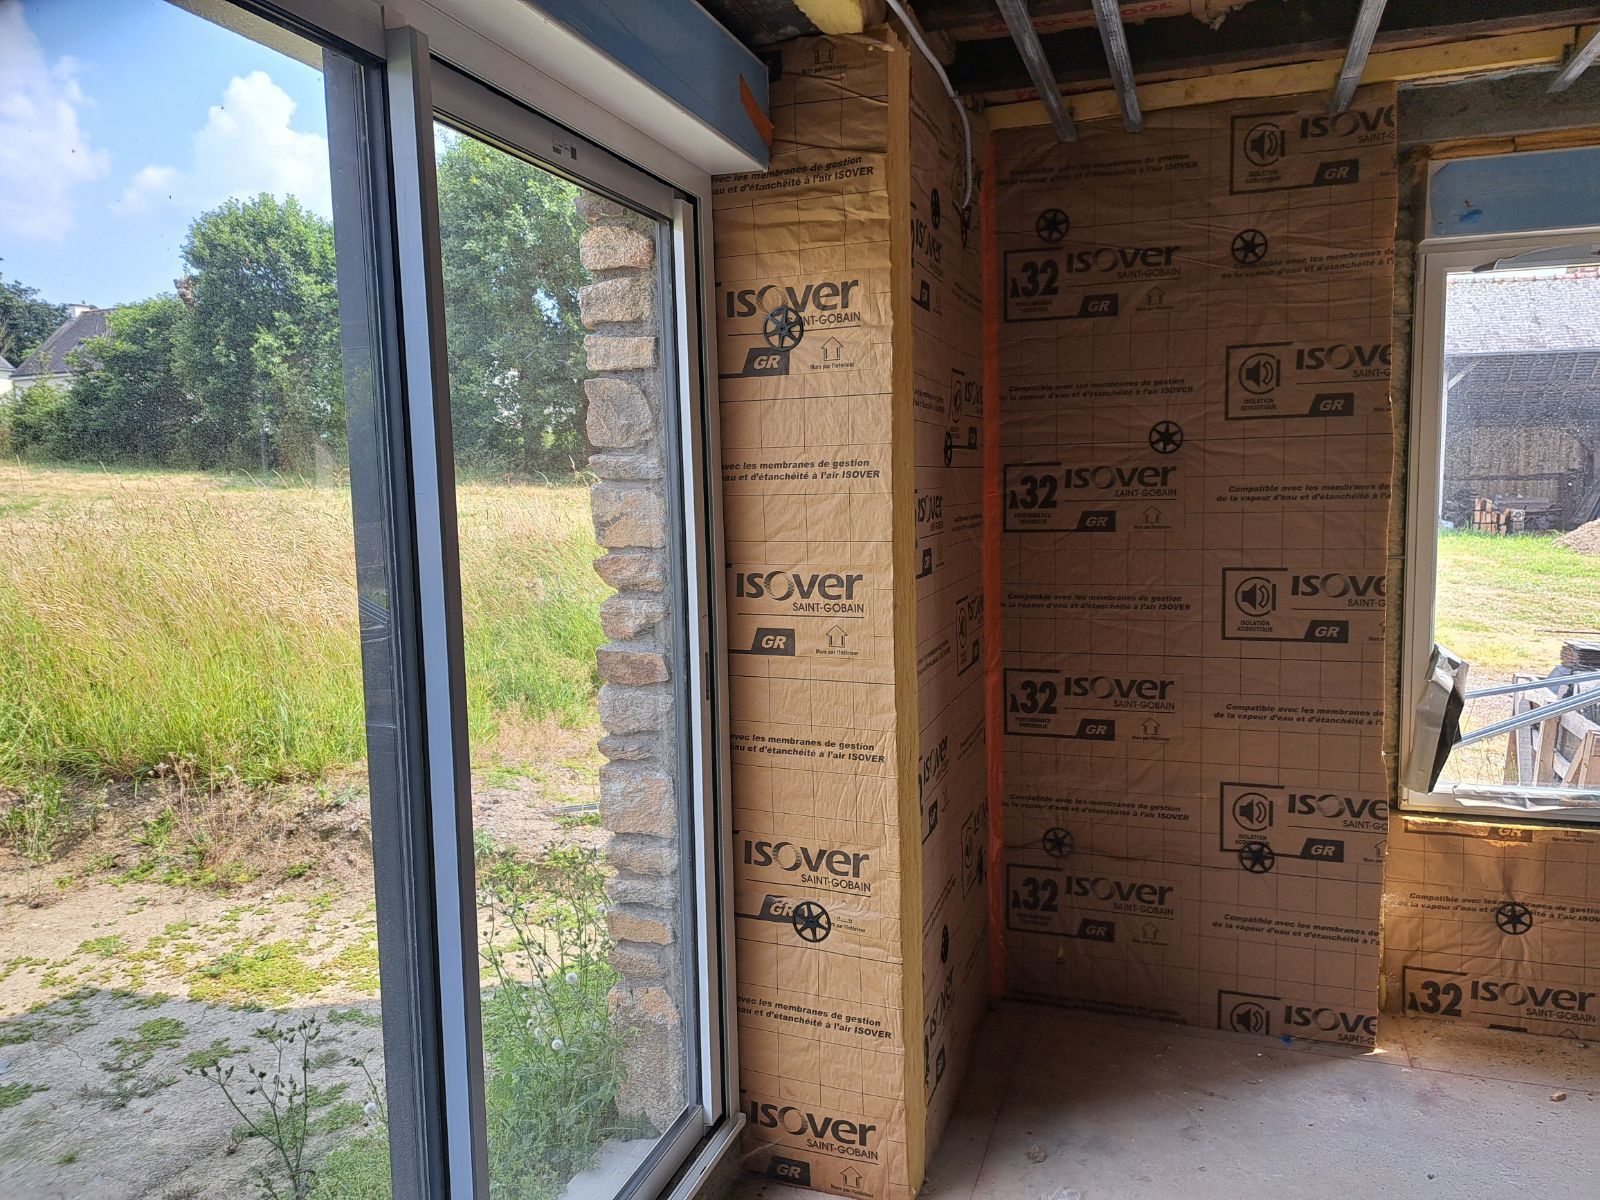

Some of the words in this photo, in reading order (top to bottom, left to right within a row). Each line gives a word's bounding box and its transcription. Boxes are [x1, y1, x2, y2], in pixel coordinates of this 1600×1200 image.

[752, 169, 807, 180] membranes
[811, 163, 822, 172] de
[826, 157, 862, 170] gestion
[813, 172, 832, 183] l'air
[834, 166, 874, 180] ISOVER
[1324, 167, 1348, 180] GR
[1116, 267, 1181, 280] SAINT-GOBAIN
[1088, 301, 1110, 312] GR
[788, 312, 860, 326] SNT-GOBAIN
[754, 356, 780, 370] GR
[1320, 400, 1344, 411] GR
[743, 462, 757, 470] les
[760, 460, 814, 470] membranes
[818, 460, 830, 468] de
[832, 459, 870, 470] gestion
[750, 472, 809, 480] d'étanchéité
[812, 471, 818, 480] à
[821, 471, 838, 479] l'air
[842, 470, 880, 478] ISOVER
[1114, 488, 1176, 498] SAINT-GOBAIN
[1229, 484, 1278, 494] Compatible
[1305, 484, 1318, 492] les
[1322, 482, 1375, 492] membranes
[1216, 494, 1228, 502] de
[1240, 496, 1270, 504] vapeur
[1086, 516, 1108, 527] GR
[792, 602, 864, 614] SAINT-GOBAIN
[1315, 627, 1340, 637] GR
[762, 635, 786, 648] GR
[1113, 700, 1175, 710] SAINT-GOBAIN
[1226, 704, 1276, 714] Compatible
[1278, 706, 1299, 714] avec
[1302, 706, 1314, 714] les
[1317, 707, 1370, 716] membranes
[1372, 709, 1384, 717] de
[1214, 711, 1226, 719] de
[1237, 713, 1267, 722] vapeur
[1270, 714, 1294, 722] d'eau
[1086, 724, 1107, 735] GR
[752, 734, 766, 742] les
[768, 736, 822, 747] membranes
[824, 738, 836, 748] de
[839, 740, 874, 750] gestion
[748, 744, 757, 752] et
[759, 746, 816, 757] d'étanchéité
[828, 750, 846, 760] l'air
[848, 752, 884, 762] ISOVER
[1158, 812, 1190, 820] ISOVER
[1312, 846, 1336, 856] GR
[801, 874, 871, 892] SAINT-GOBAIN
[1410, 893, 1458, 904] Compatible
[1114, 902, 1175, 916] SAINT-GOBAIN
[1453, 904, 1476, 912] d'eau
[1558, 912, 1576, 920] l'air
[1086, 925, 1108, 936] GR
[1212, 920, 1223, 928] de
[1235, 924, 1264, 933] vapeur
[1266, 926, 1290, 935] d'eau
[1292, 928, 1302, 936] et
[1224, 914, 1272, 926] Compatible
[1275, 920, 1296, 928] avec
[1298, 920, 1310, 929] les
[1313, 922, 1366, 935] membranes
[759, 998, 772, 1008] les
[775, 1002, 828, 1018] membranes
[832, 1010, 843, 1020] de
[846, 1014, 881, 1027] gestion
[1526, 1008, 1596, 1022] SAINT-GOBAIN
[754, 1008, 764, 1016] et
[766, 1010, 822, 1028] d'étanchéité
[826, 1021, 831, 1029] à
[834, 1022, 852, 1033] l'air
[854, 1026, 892, 1040] ISOVER
[806, 1138, 878, 1160] SAINT-GOBAIN
[776, 1164, 801, 1179] GR
